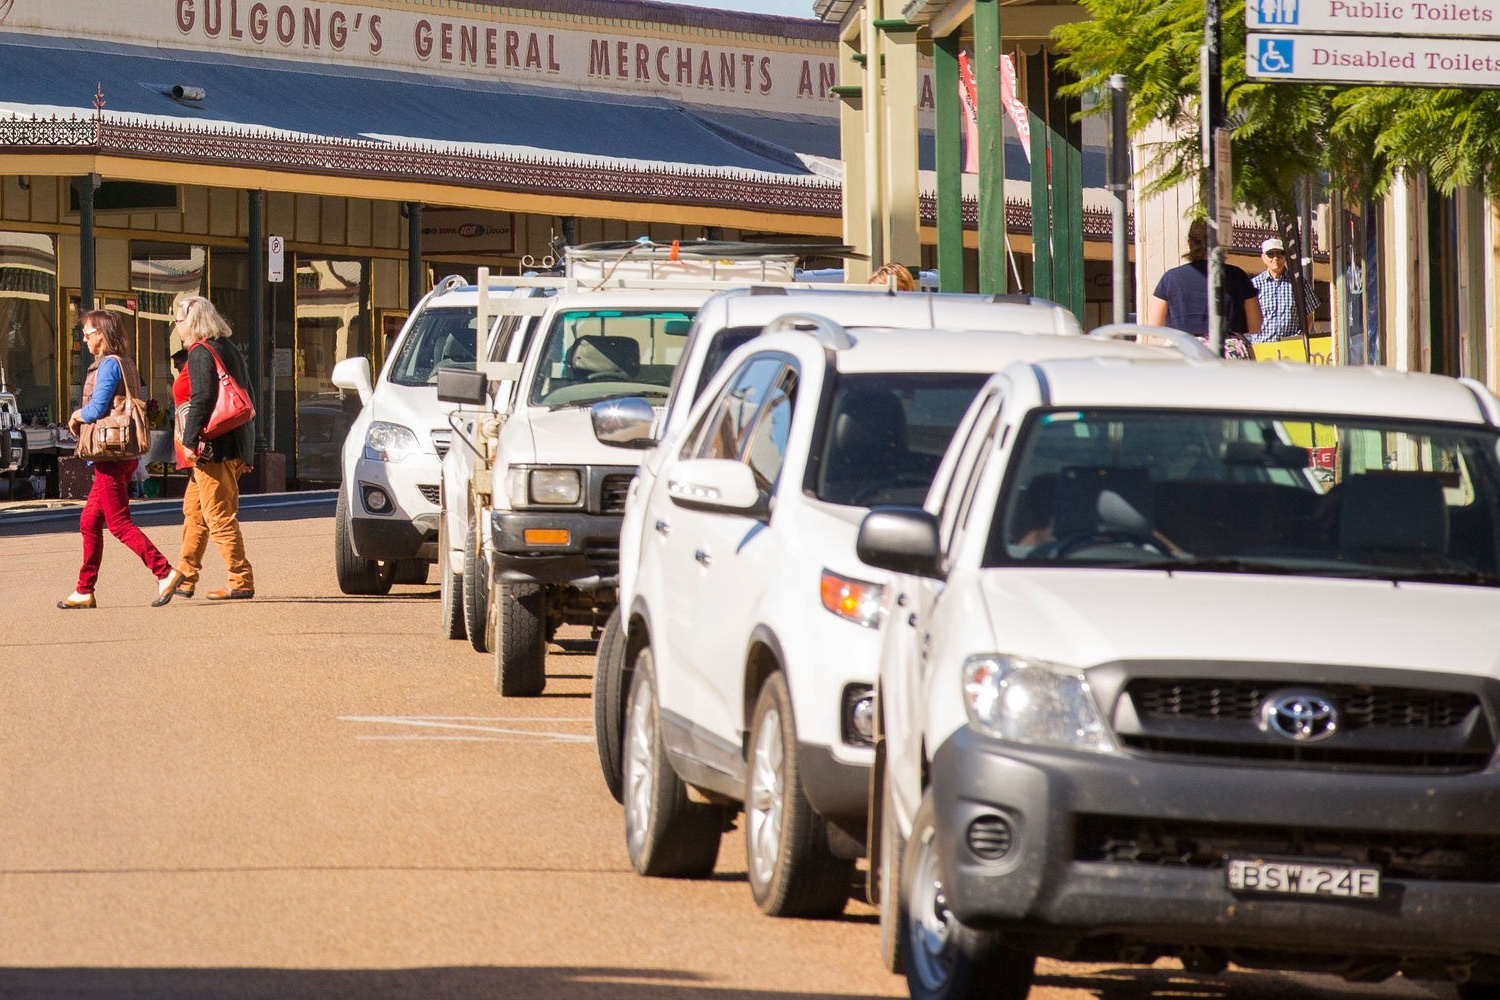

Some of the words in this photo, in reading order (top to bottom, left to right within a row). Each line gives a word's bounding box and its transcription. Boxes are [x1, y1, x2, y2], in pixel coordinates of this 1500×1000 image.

[1329, 0, 1404, 19] Public
[1411, 2, 1493, 22] Toilets
[414, 19, 561, 74] GENERAL
[588, 39, 773, 95] MERCHANTS
[797, 60, 836, 101] AN
[1312, 48, 1416, 69] Disabled
[1424, 53, 1500, 72] Toilets
[460, 226, 477, 235] IGA
